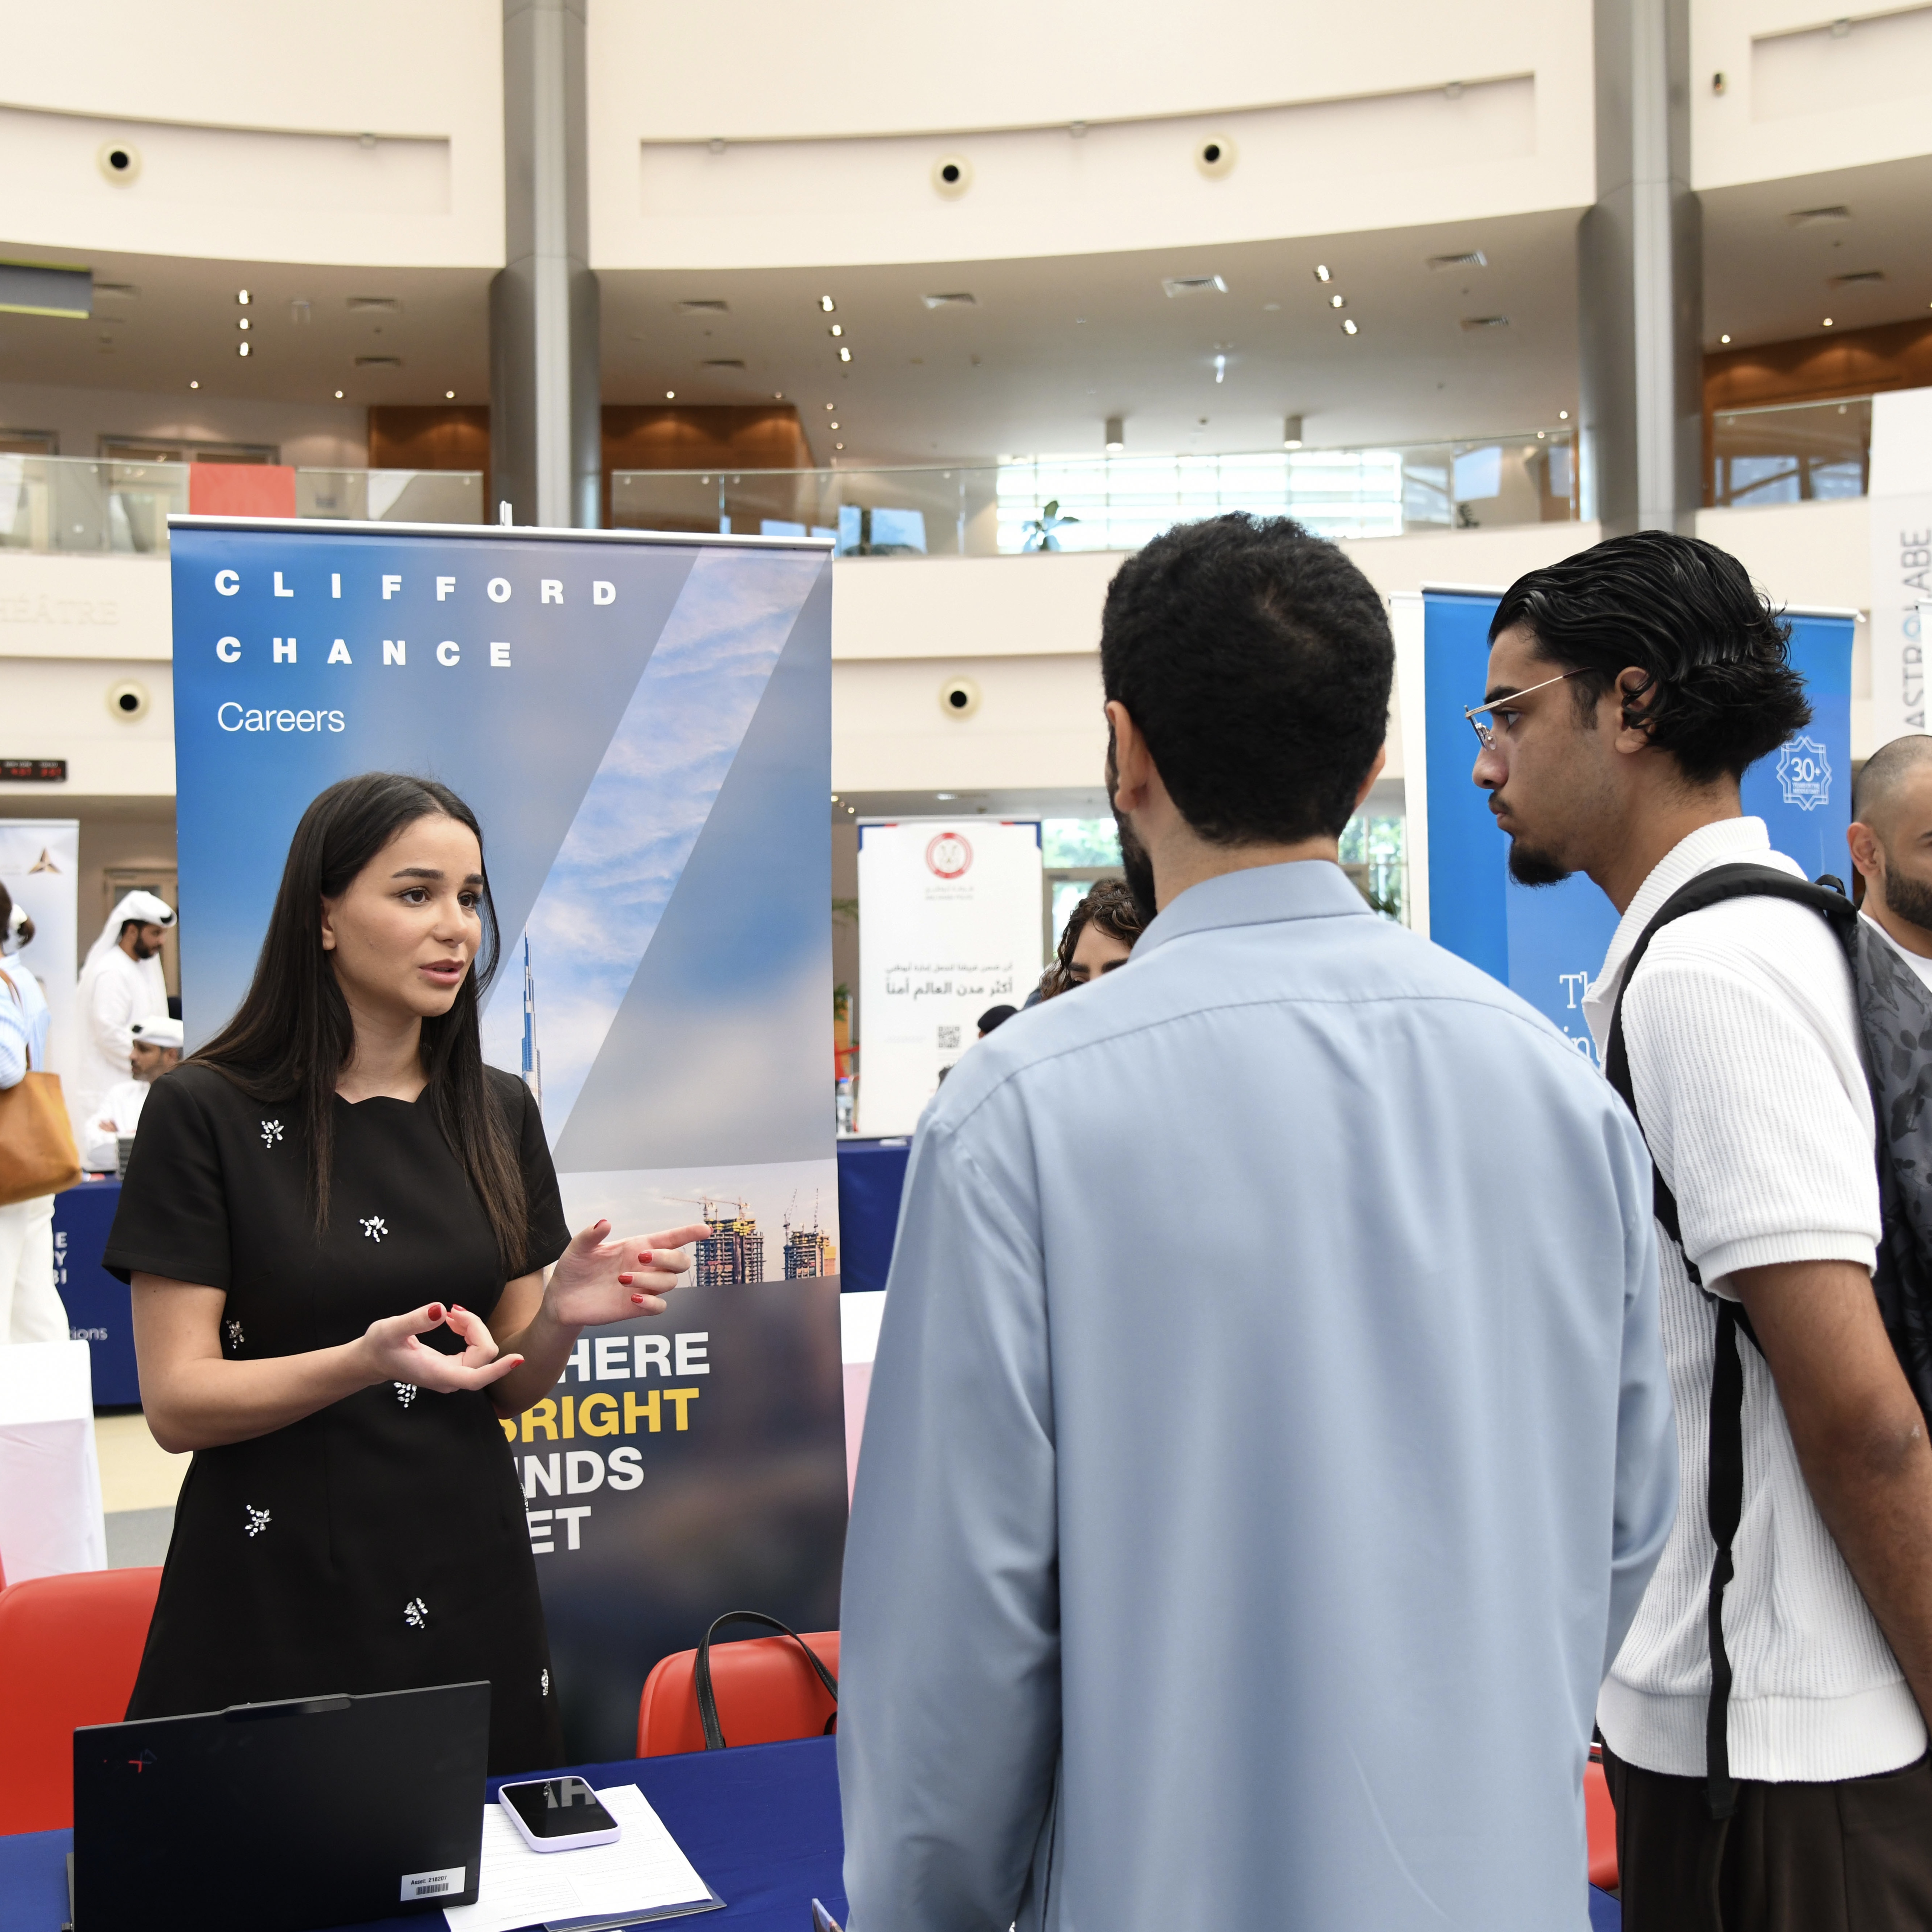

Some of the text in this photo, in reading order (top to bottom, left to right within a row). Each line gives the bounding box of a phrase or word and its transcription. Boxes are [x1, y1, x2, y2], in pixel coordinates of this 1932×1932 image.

[214, 569, 616, 605] CLIFFORD
[216, 636, 511, 667] CHANCE
[217, 702, 345, 732] Careers
[1791, 757, 1821, 782] 30+
[913, 981, 952, 1000] العالم
